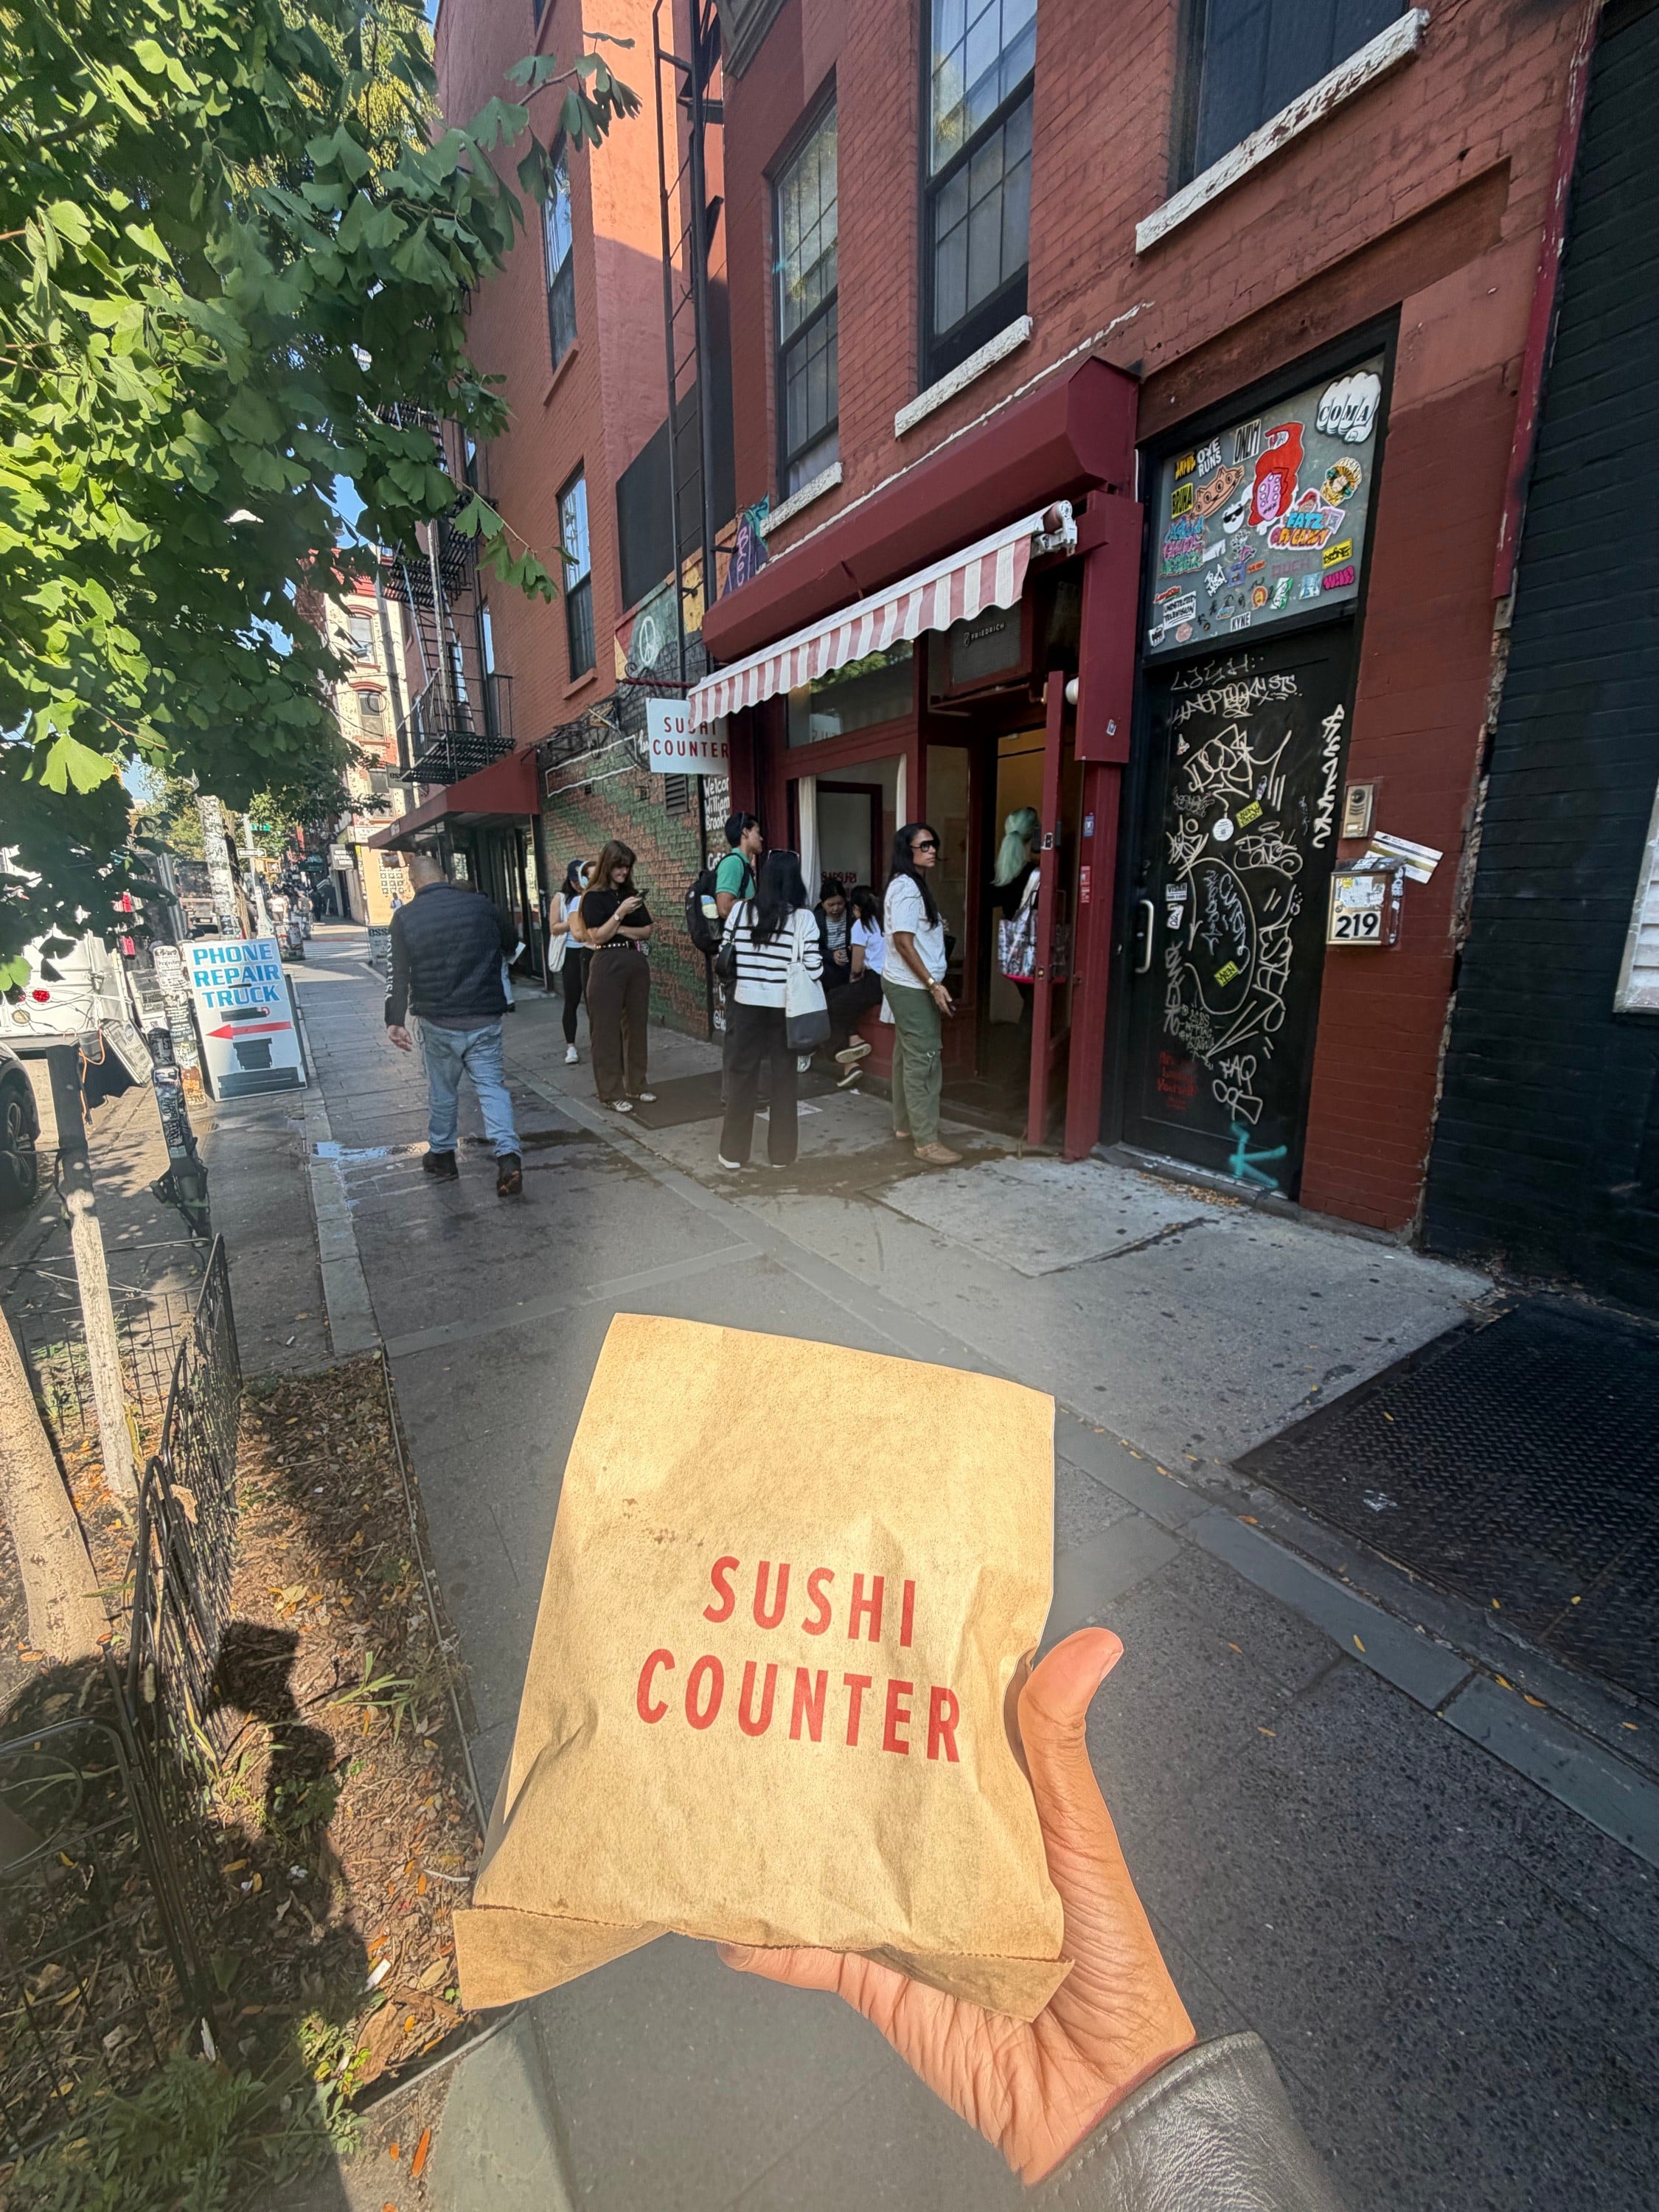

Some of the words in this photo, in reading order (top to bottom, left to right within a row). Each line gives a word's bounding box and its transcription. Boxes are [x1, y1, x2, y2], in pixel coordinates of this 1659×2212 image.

[1319, 405, 1369, 422] COMA
[1197, 437, 1220, 463] OYE
[1198, 451, 1222, 477] RUNS
[971, 622, 1004, 640] FRIEDRICH
[1232, 613, 1251, 630] KYNE
[653, 740, 730, 758] COUNTER
[704, 796, 730, 815] William
[1335, 913, 1379, 939] 219
[192, 944, 273, 965] PHONE
[193, 964, 280, 987] REPAIR
[202, 985, 279, 1008] TRUCK
[703, 1556, 915, 1647] SUSHI
[637, 1649, 960, 1762] COUNTER
